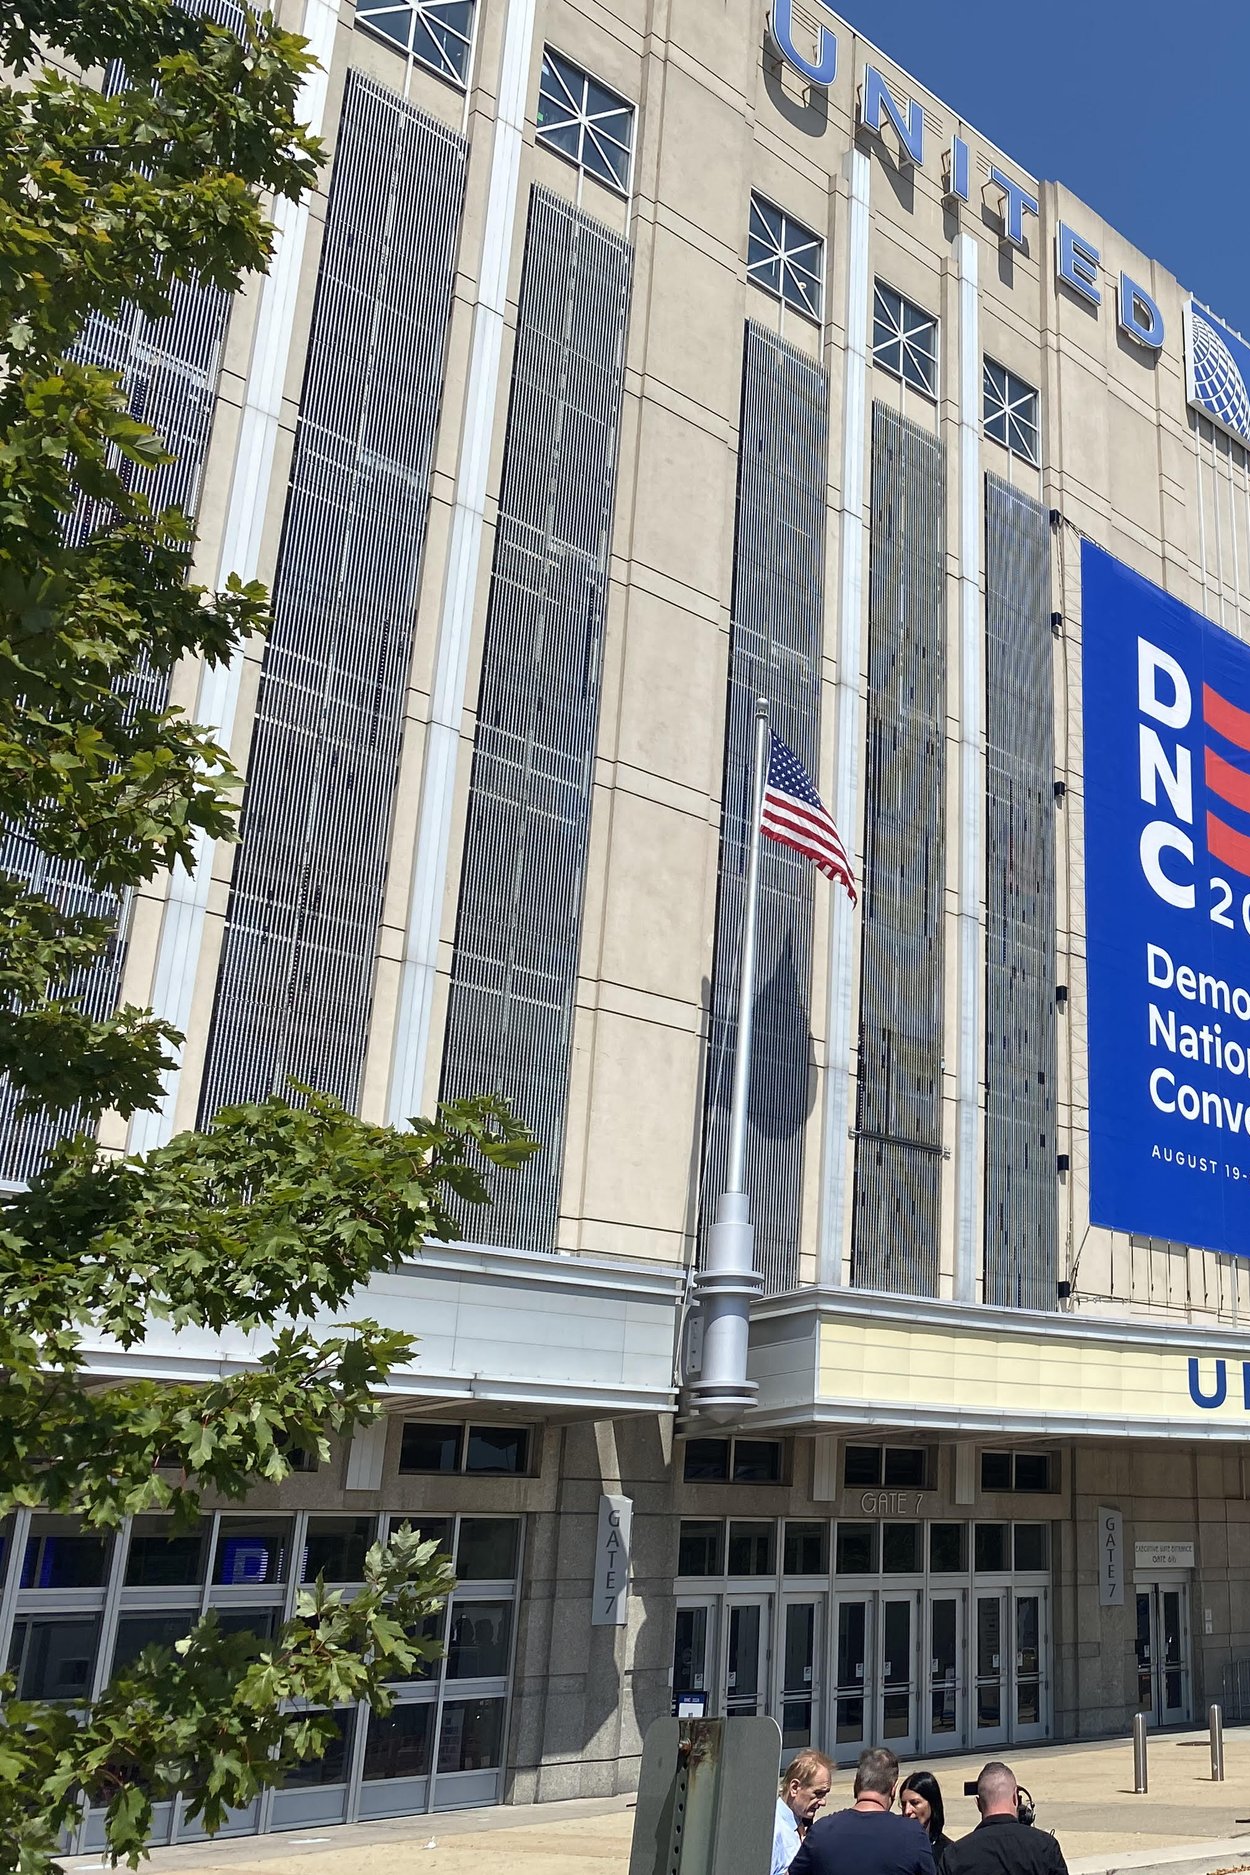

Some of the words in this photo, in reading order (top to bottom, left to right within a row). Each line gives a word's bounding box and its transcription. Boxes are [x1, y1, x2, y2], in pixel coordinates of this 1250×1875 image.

[770, 0, 1165, 350] UNITED
[1137, 635, 1196, 909] DNC
[1151, 1144, 1217, 1174] AUGUST
[861, 1492, 907, 1514] GATE
[916, 1493, 924, 1514] 7
[606, 1509, 621, 1589] GATE
[1105, 1517, 1116, 1579] GATE
[604, 1596, 616, 1615] 7
[1108, 1583, 1116, 1598] 7
